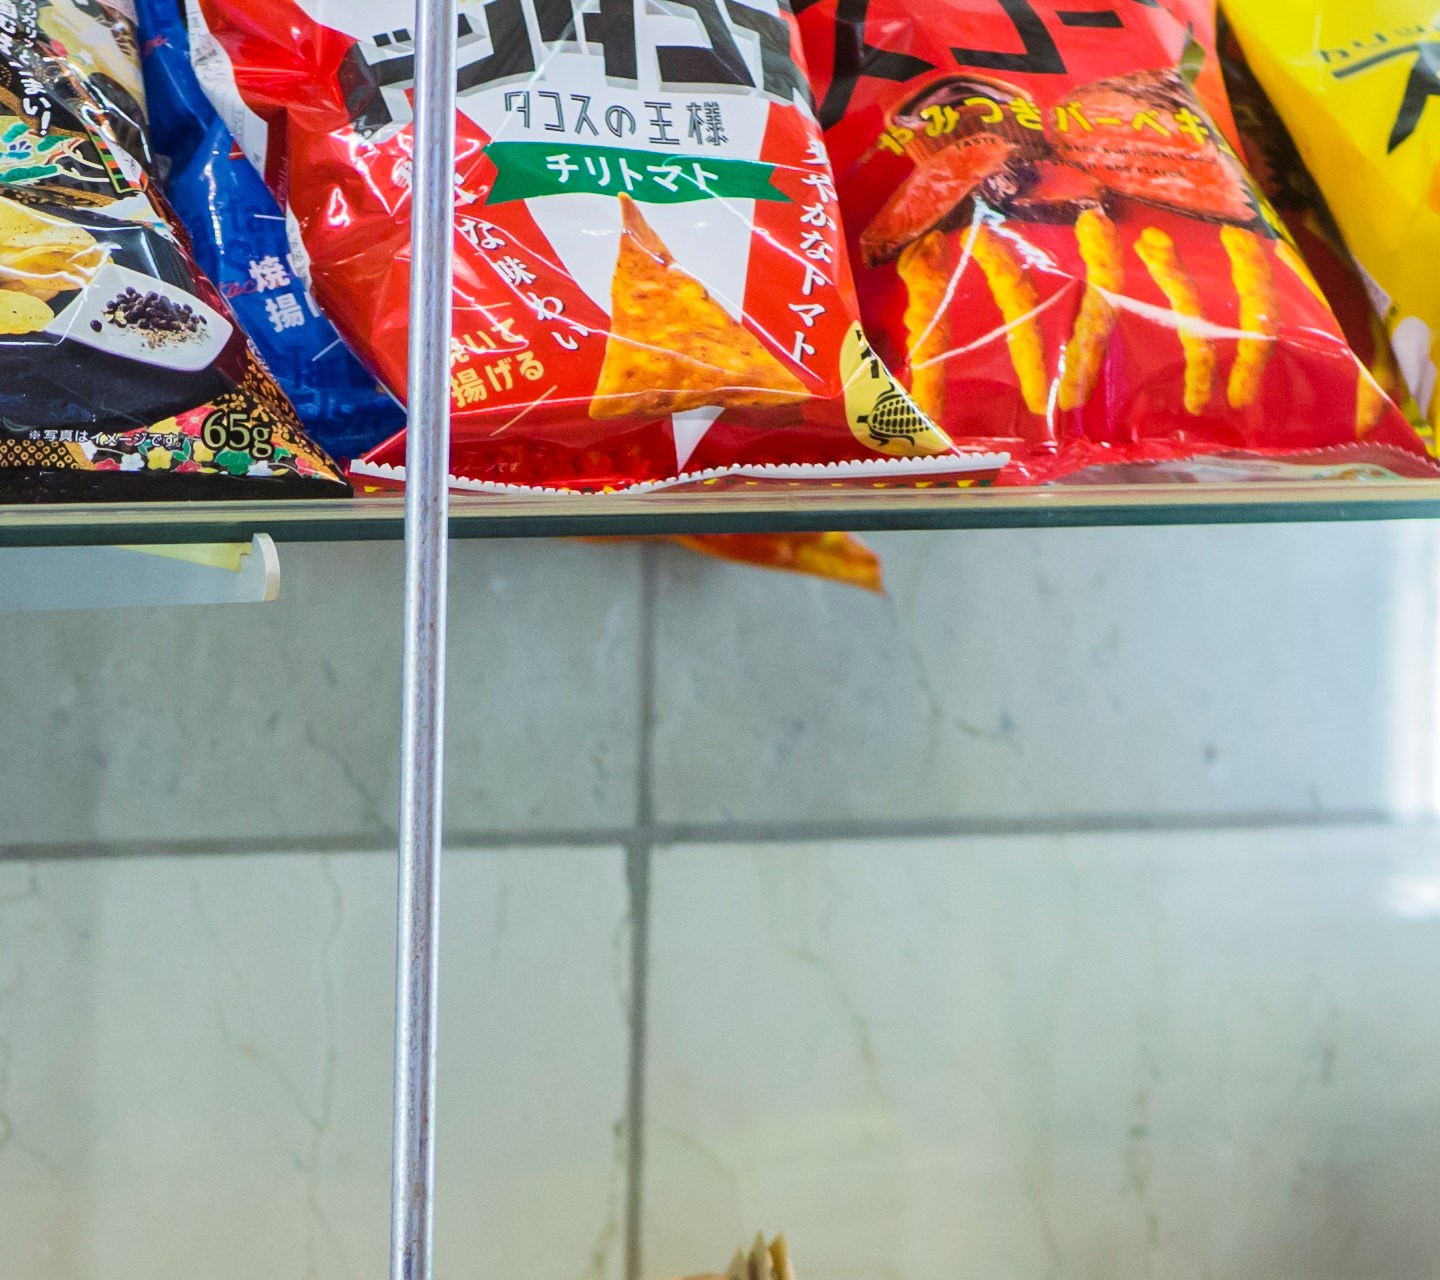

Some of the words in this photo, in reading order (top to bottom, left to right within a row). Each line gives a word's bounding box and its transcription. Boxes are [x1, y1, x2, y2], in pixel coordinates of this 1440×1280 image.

[503, 91, 729, 146] タコスの王様
[546, 153, 720, 192] チリトマト
[451, 352, 545, 409] 揚げる
[202, 410, 272, 458] 65g
